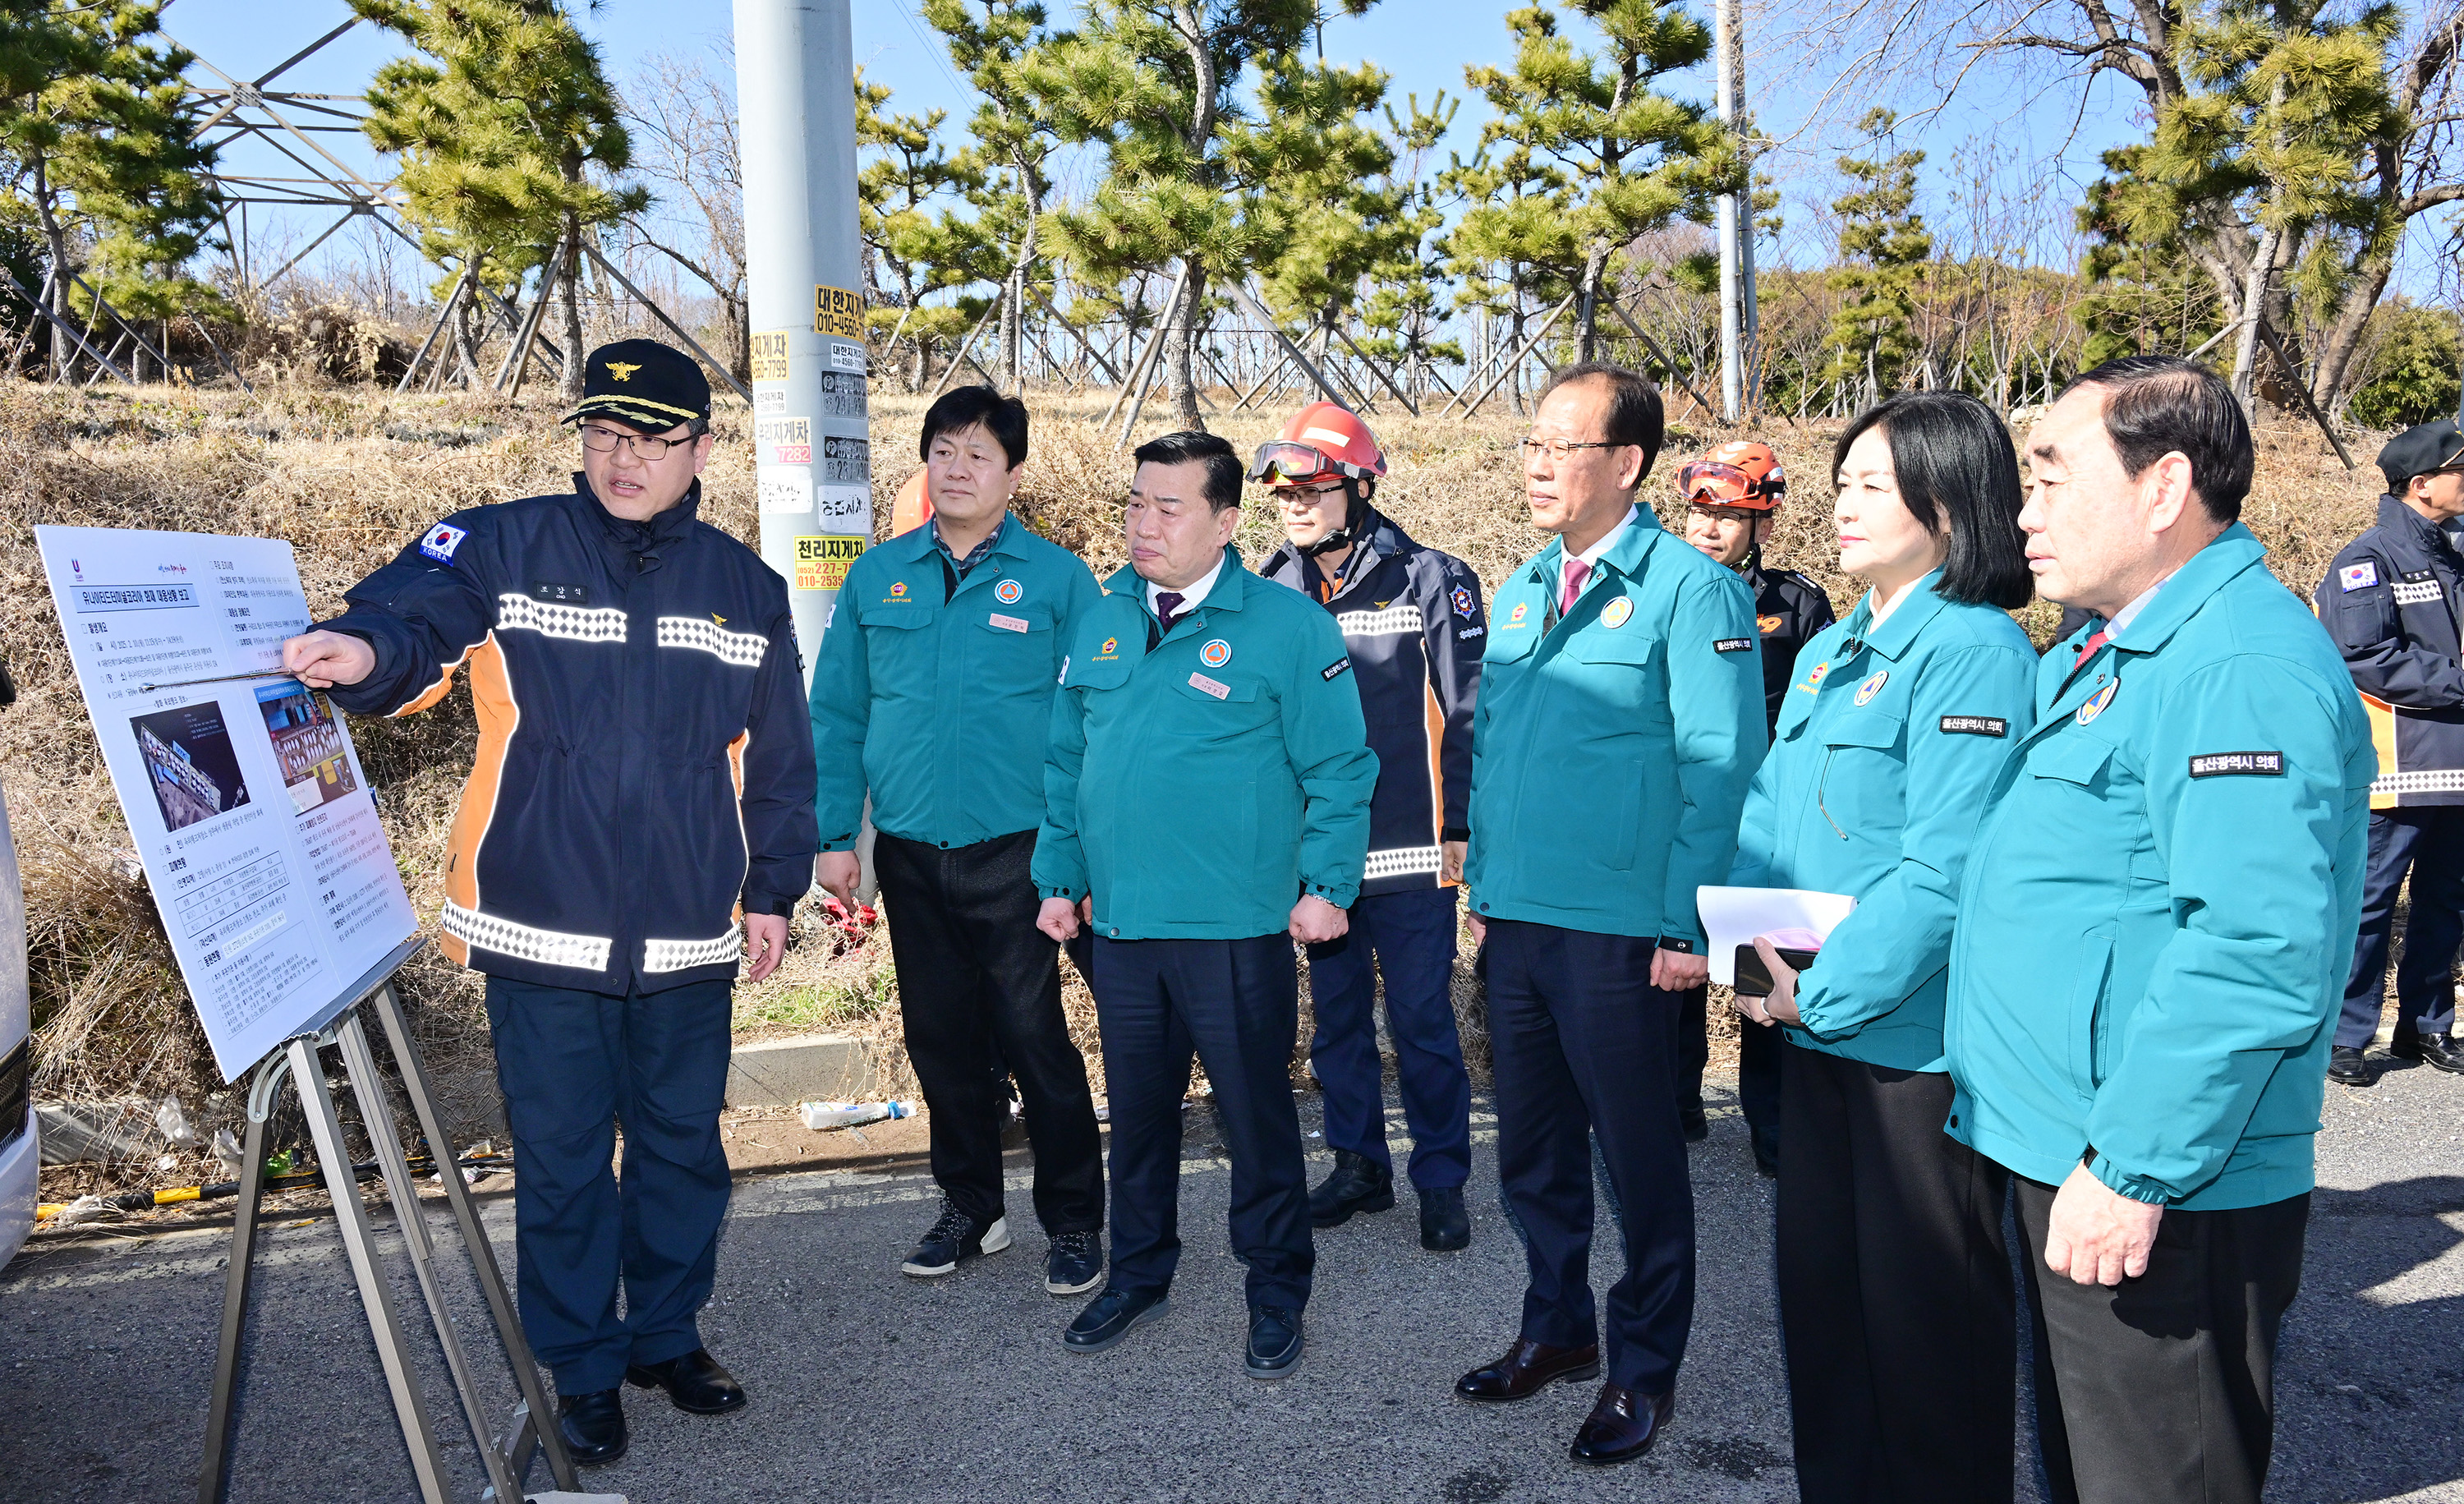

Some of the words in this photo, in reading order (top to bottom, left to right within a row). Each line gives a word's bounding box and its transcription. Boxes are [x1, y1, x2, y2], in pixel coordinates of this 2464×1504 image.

[833, 345, 863, 361] 대한지게차
[758, 420, 809, 445] 우리지게차
[779, 446, 810, 462] 7282
[423, 546, 448, 562] KOREA
[798, 540, 863, 559] 천리지게차
[2346, 581, 2374, 591] KOREA
[83, 591, 143, 604] 유나이티드터미널코리아
[144, 590, 156, 602] 화재
[156, 589, 177, 601] 대응상황
[177, 589, 189, 600] 보고
[88, 622, 108, 633] 발생개요
[1942, 718, 1984, 731] 울산광역시
[1986, 720, 2002, 733] 의회
[2192, 755, 2253, 772] 울산광역시
[2255, 755, 2278, 770] 의회
[168, 858, 186, 872] 피해현황
[204, 950, 220, 967] 동원현황
